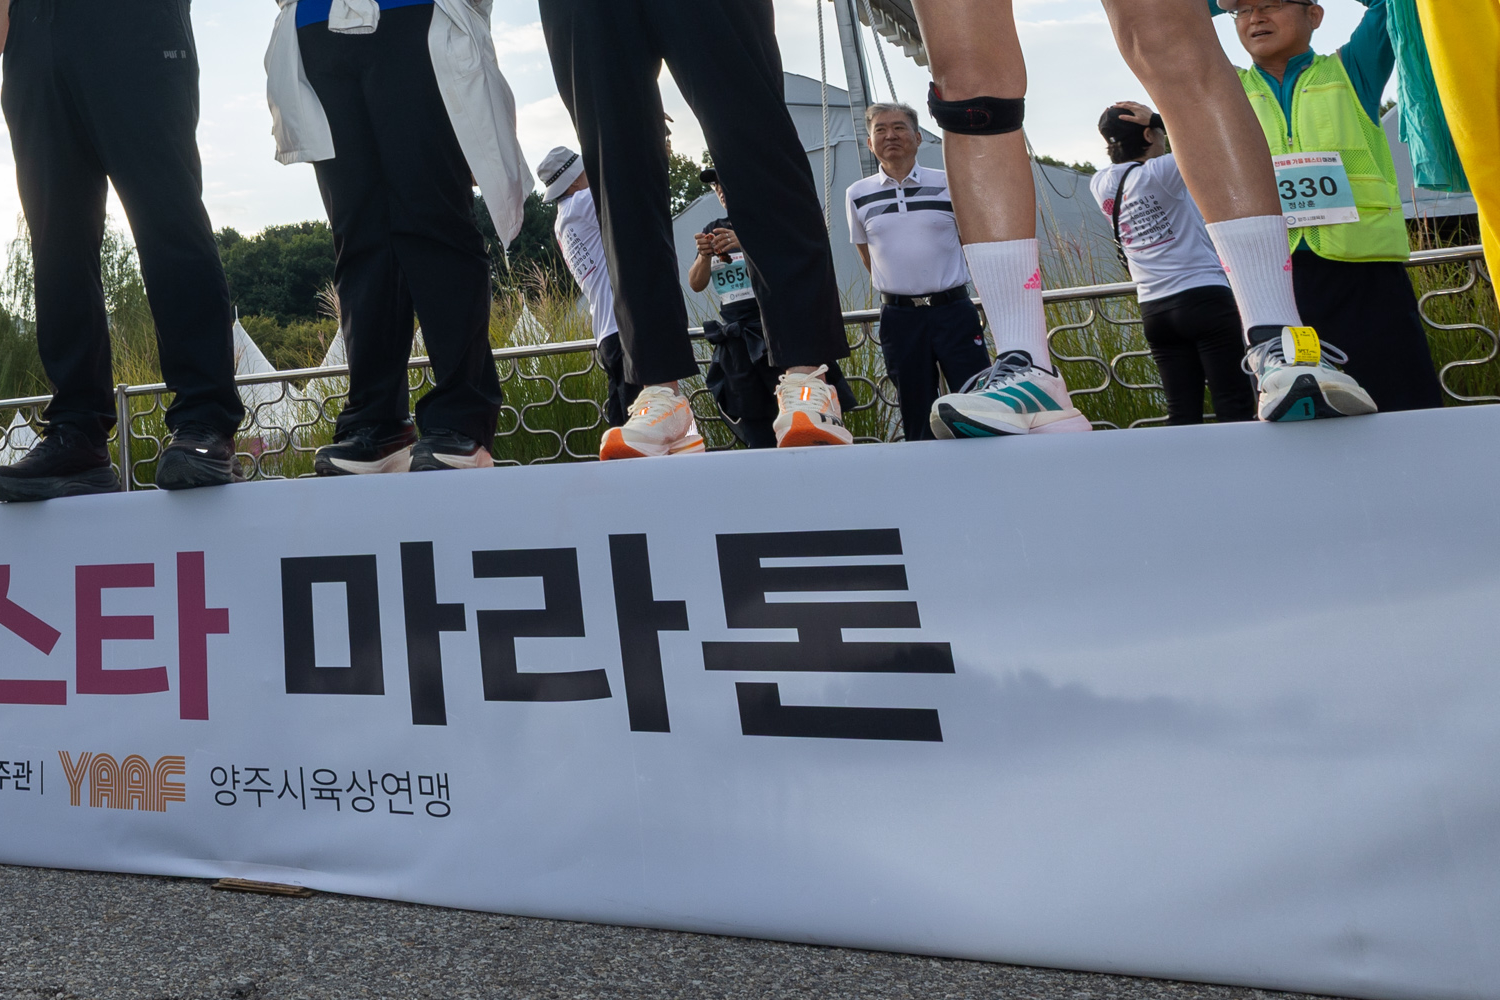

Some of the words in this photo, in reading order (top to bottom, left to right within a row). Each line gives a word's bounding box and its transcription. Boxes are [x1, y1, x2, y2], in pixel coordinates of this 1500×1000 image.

[281, 528, 956, 742] 마라톤
[58, 750, 186, 813] YAAF
[209, 763, 451, 819] 양주시육상연맹
